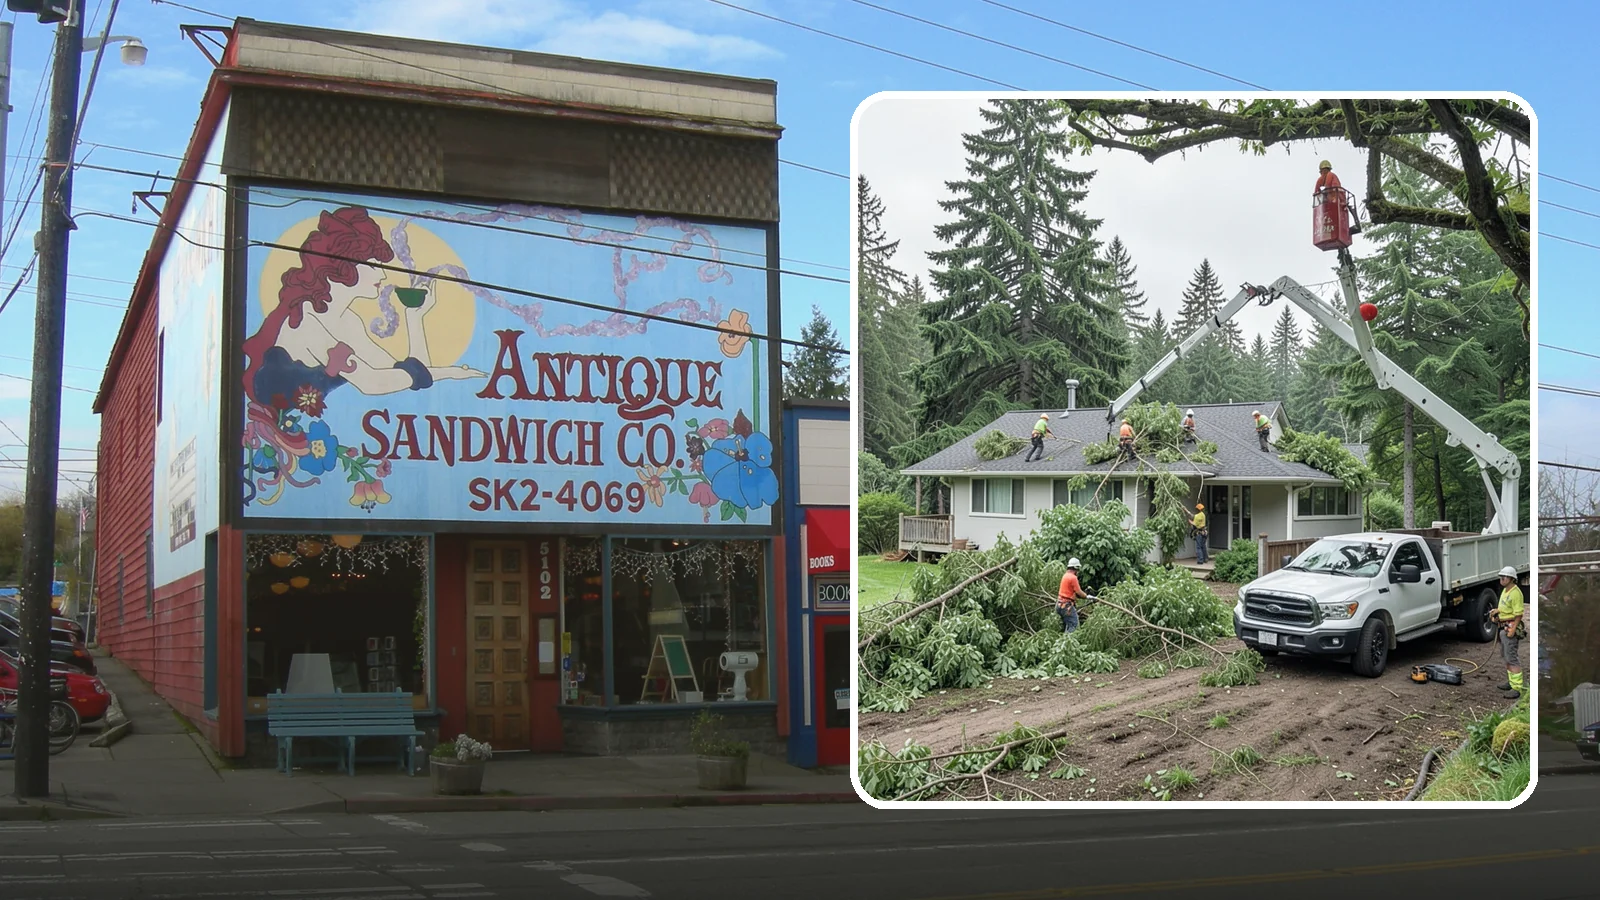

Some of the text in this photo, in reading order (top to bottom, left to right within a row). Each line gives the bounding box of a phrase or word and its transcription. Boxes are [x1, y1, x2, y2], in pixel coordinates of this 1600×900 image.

[476, 329, 724, 421] ANTIQUE
[361, 408, 685, 468] SANDWICH CO.
[468, 477, 646, 512] SK2-4069
[540, 541, 552, 599] 5102
[809, 555, 835, 569] BOOKS
